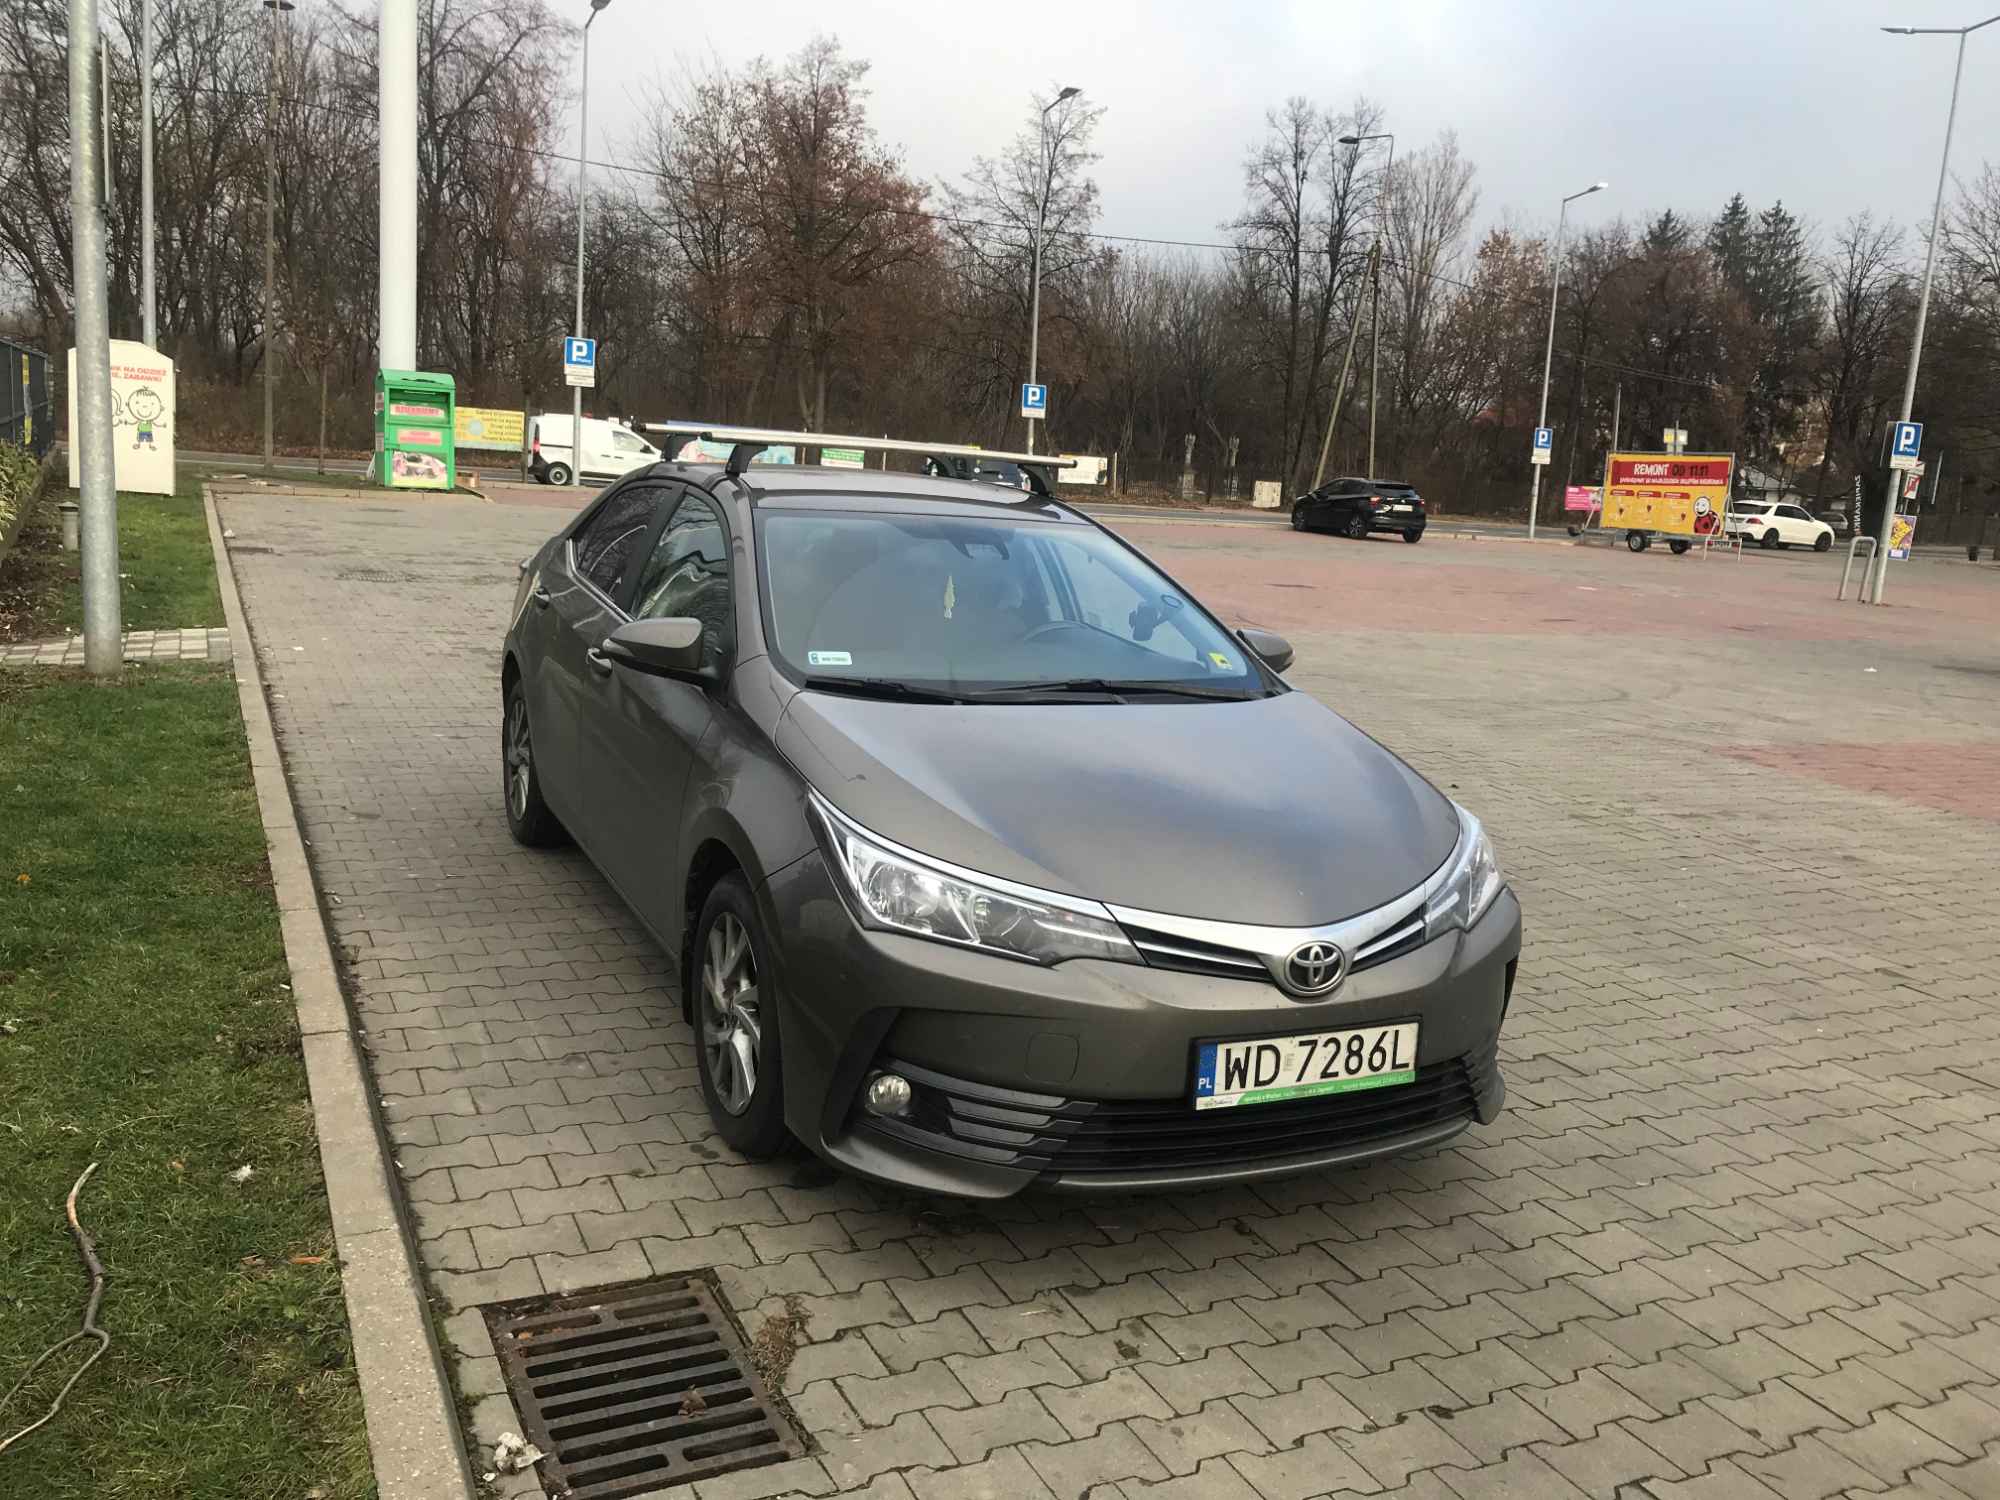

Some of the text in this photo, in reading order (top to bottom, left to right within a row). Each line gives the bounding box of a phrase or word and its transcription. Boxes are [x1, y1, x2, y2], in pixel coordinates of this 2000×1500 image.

[572, 340, 588, 362] P
[1027, 386, 1041, 406] P
[1538, 430, 1549, 446] P
[1899, 425, 1916, 452] P
[1633, 463, 1670, 475] REMONT
[1224, 1029, 1410, 1091] WD 7286L
[1198, 1077, 1212, 1089] PL
